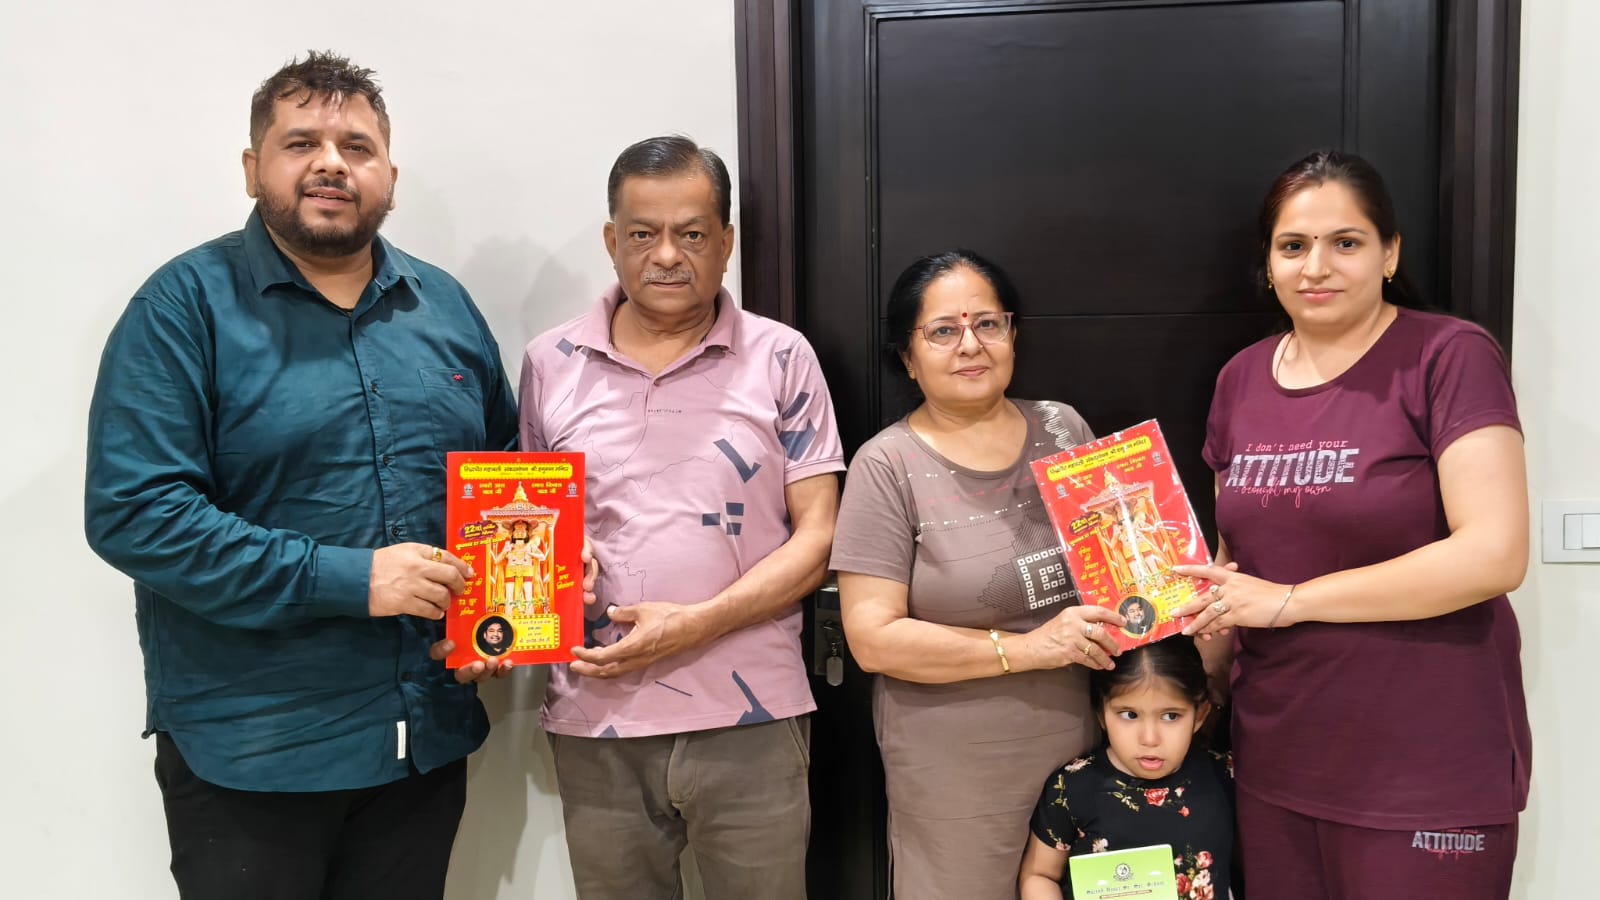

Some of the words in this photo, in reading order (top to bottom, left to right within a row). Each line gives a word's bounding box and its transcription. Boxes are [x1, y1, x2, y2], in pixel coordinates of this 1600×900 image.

[1245, 443, 1253, 452] I
[1255, 442, 1284, 452] don't
[1288, 440, 1313, 452] need
[1316, 440, 1349, 451] your
[1225, 448, 1360, 487] ATTITUDE
[1283, 486, 1302, 509] my
[1304, 485, 1332, 496] own
[1411, 831, 1486, 851] ATTITUDE
